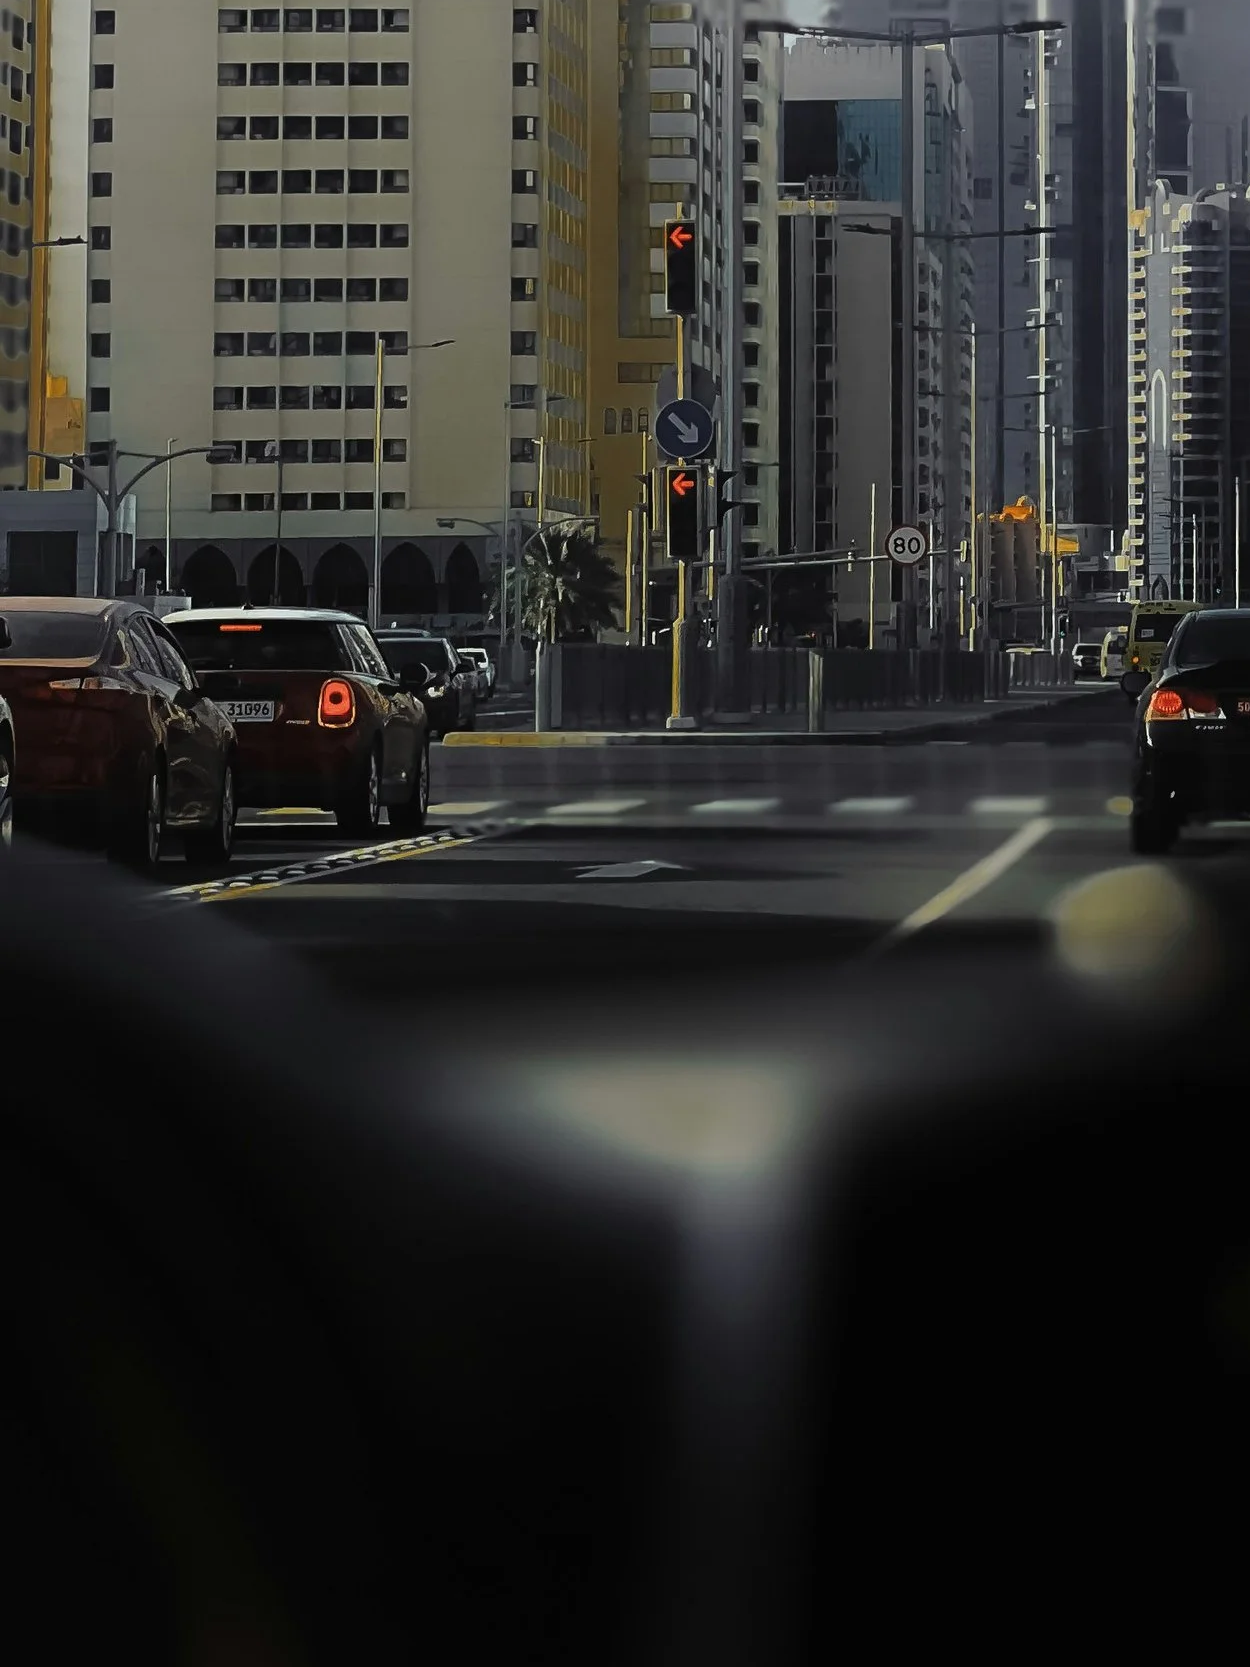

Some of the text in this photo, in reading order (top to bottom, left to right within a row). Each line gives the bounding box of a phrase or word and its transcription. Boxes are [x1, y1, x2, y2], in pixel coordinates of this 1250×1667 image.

[894, 537, 920, 554] 80
[227, 703, 270, 716] 31096
[1237, 701, 1250, 712] 50
